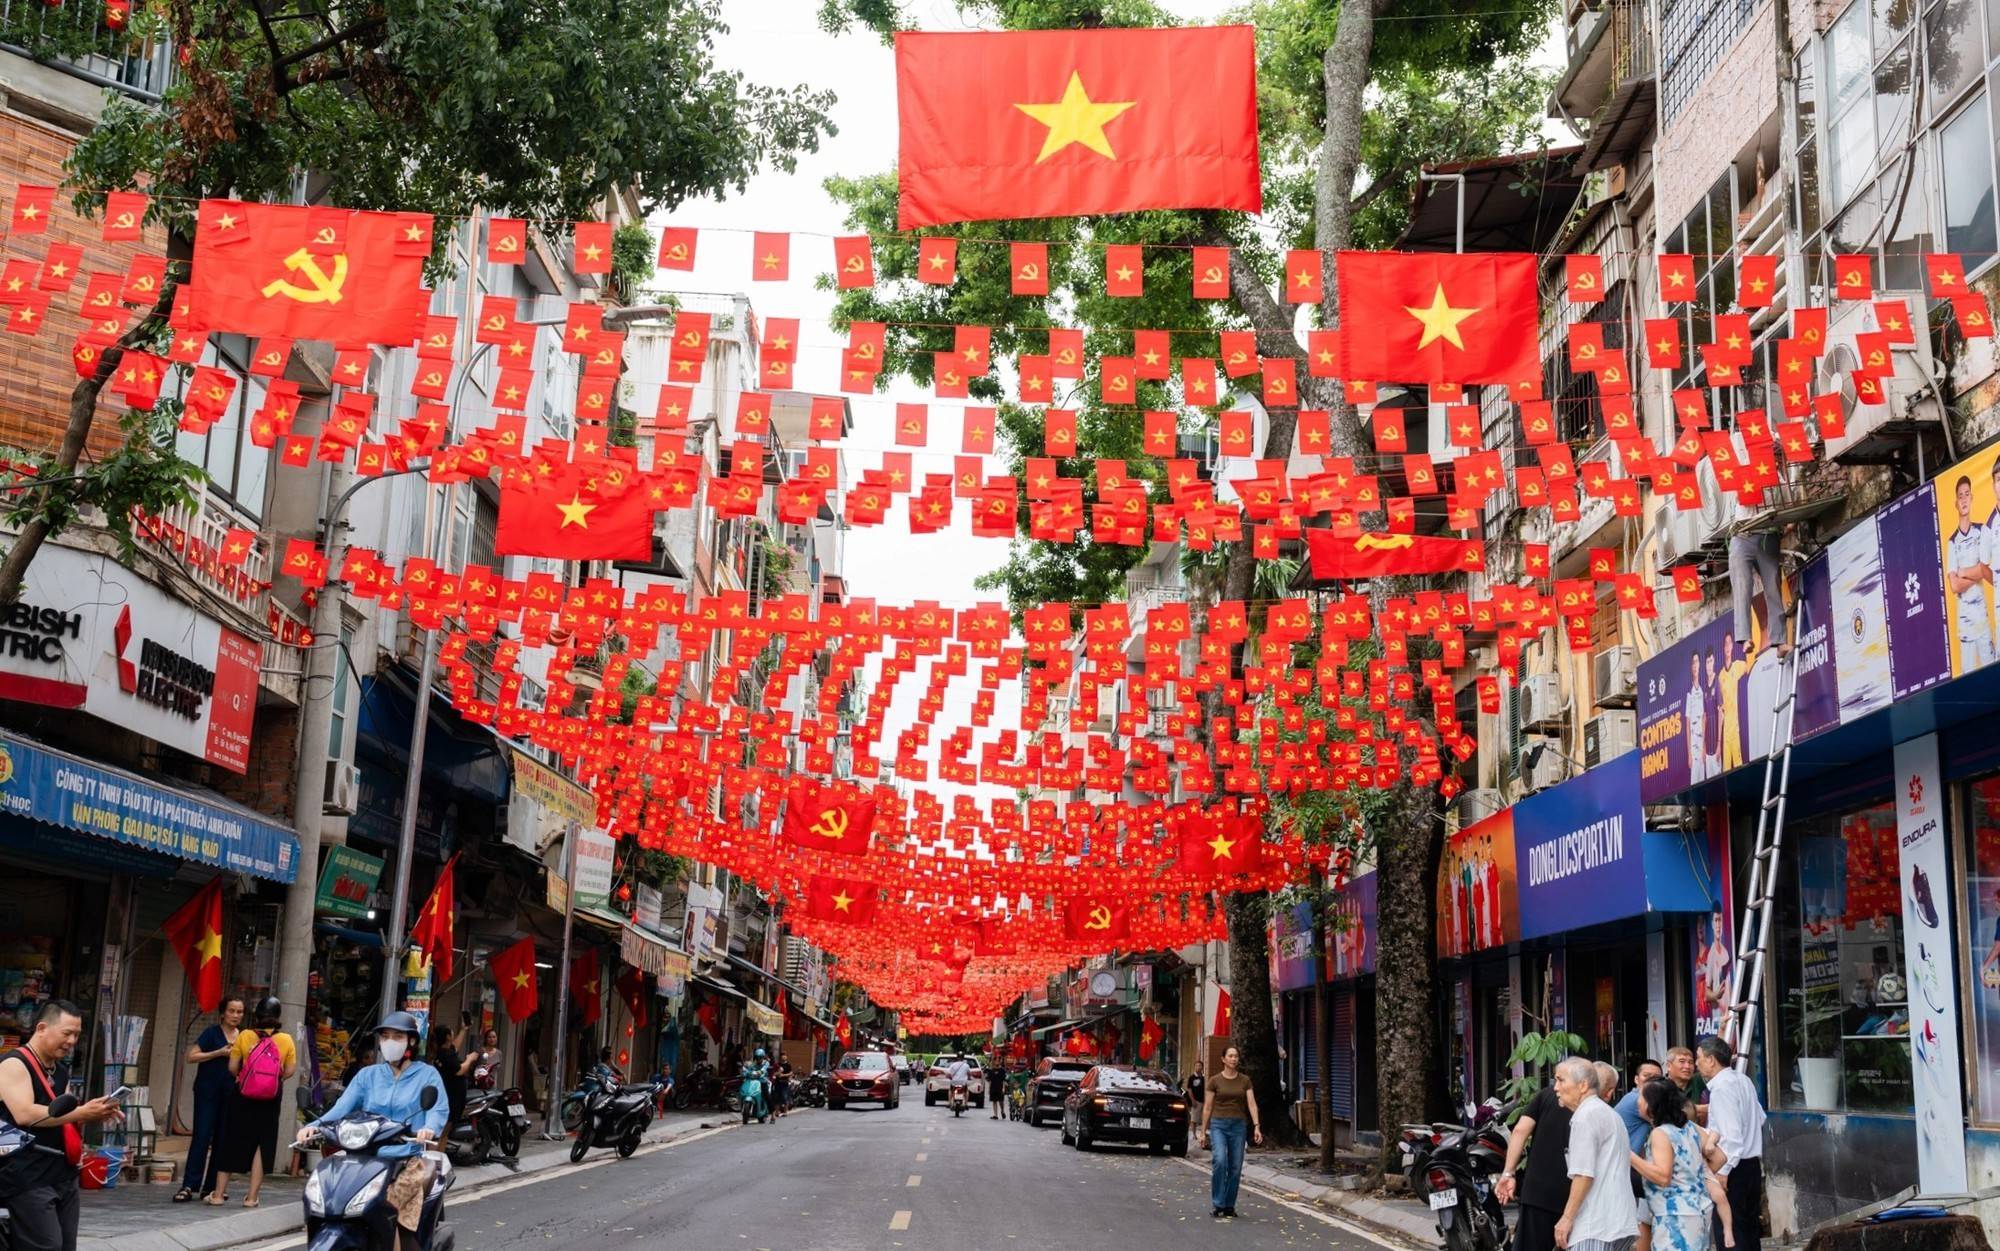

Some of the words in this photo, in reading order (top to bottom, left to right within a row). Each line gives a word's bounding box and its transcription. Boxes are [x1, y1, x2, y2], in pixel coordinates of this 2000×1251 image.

[1799, 624, 1827, 652] ONTRAS
[1799, 640, 1828, 676] HANOI
[1641, 712, 1682, 751] CONTRAS
[1641, 747, 1668, 779] HANOI
[56, 767, 84, 794] CÔNG
[85, 778, 97, 797] TY
[1903, 818, 1937, 848] ENDURA
[1529, 814, 1623, 887] DONGLUCSPORT.VN
